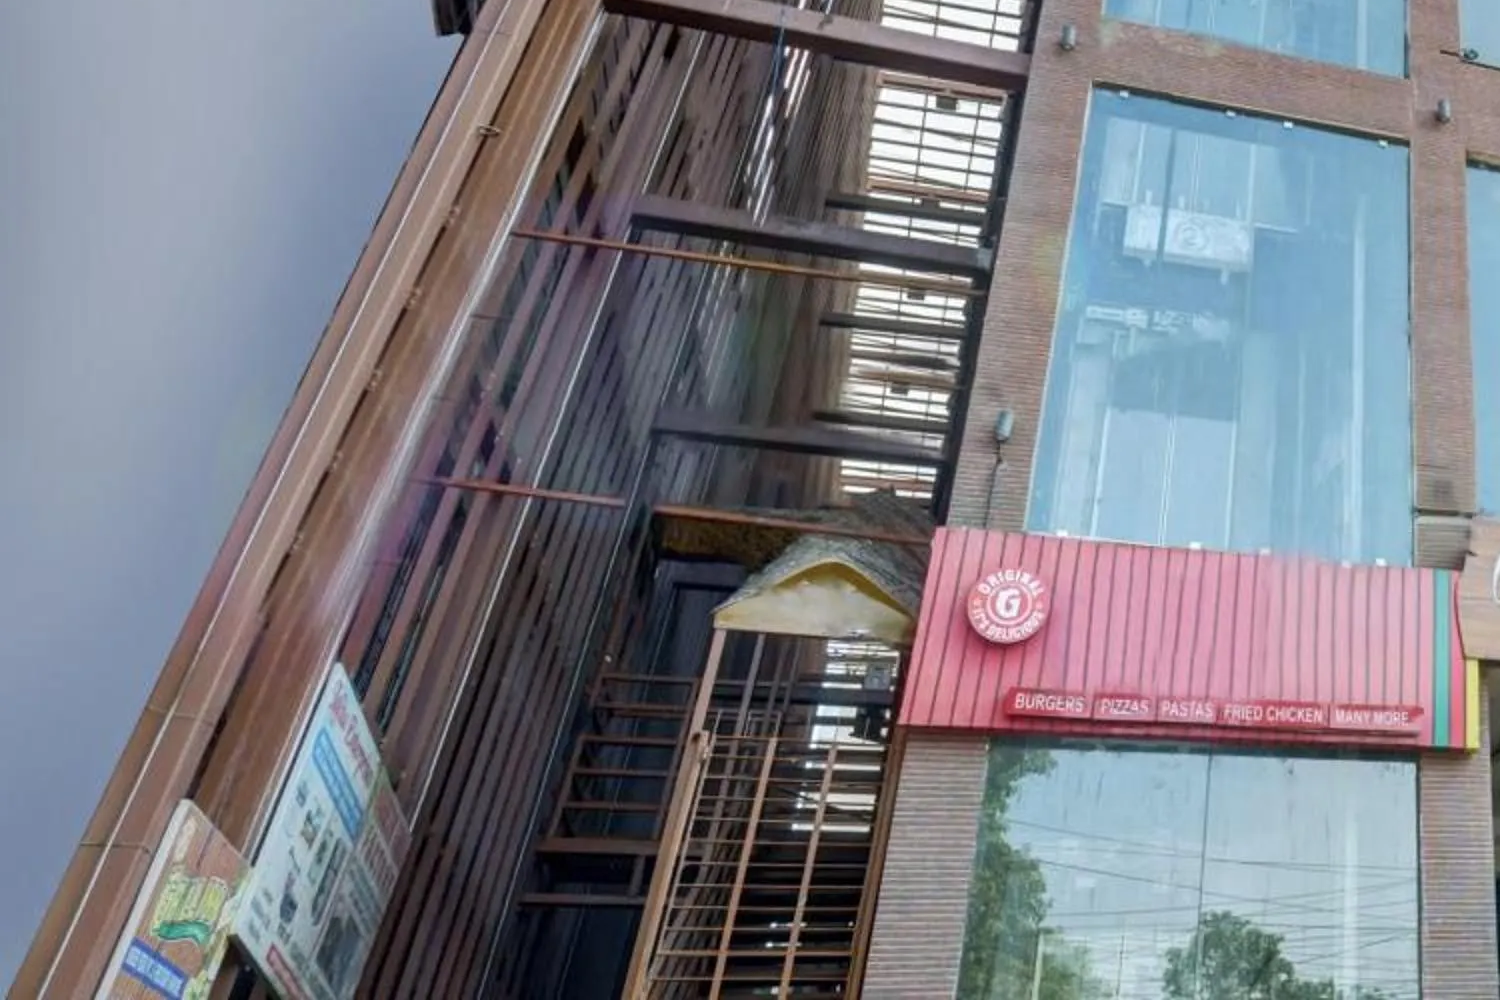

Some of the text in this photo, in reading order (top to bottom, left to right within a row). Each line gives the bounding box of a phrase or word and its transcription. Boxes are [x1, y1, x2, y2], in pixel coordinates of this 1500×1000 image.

[977, 568, 1045, 598] ORIGINAL
[995, 588, 1021, 618] G
[1014, 692, 1410, 727] BURGERS PIZZAS PASTAS FRIED CHICKEN MANY MORE
